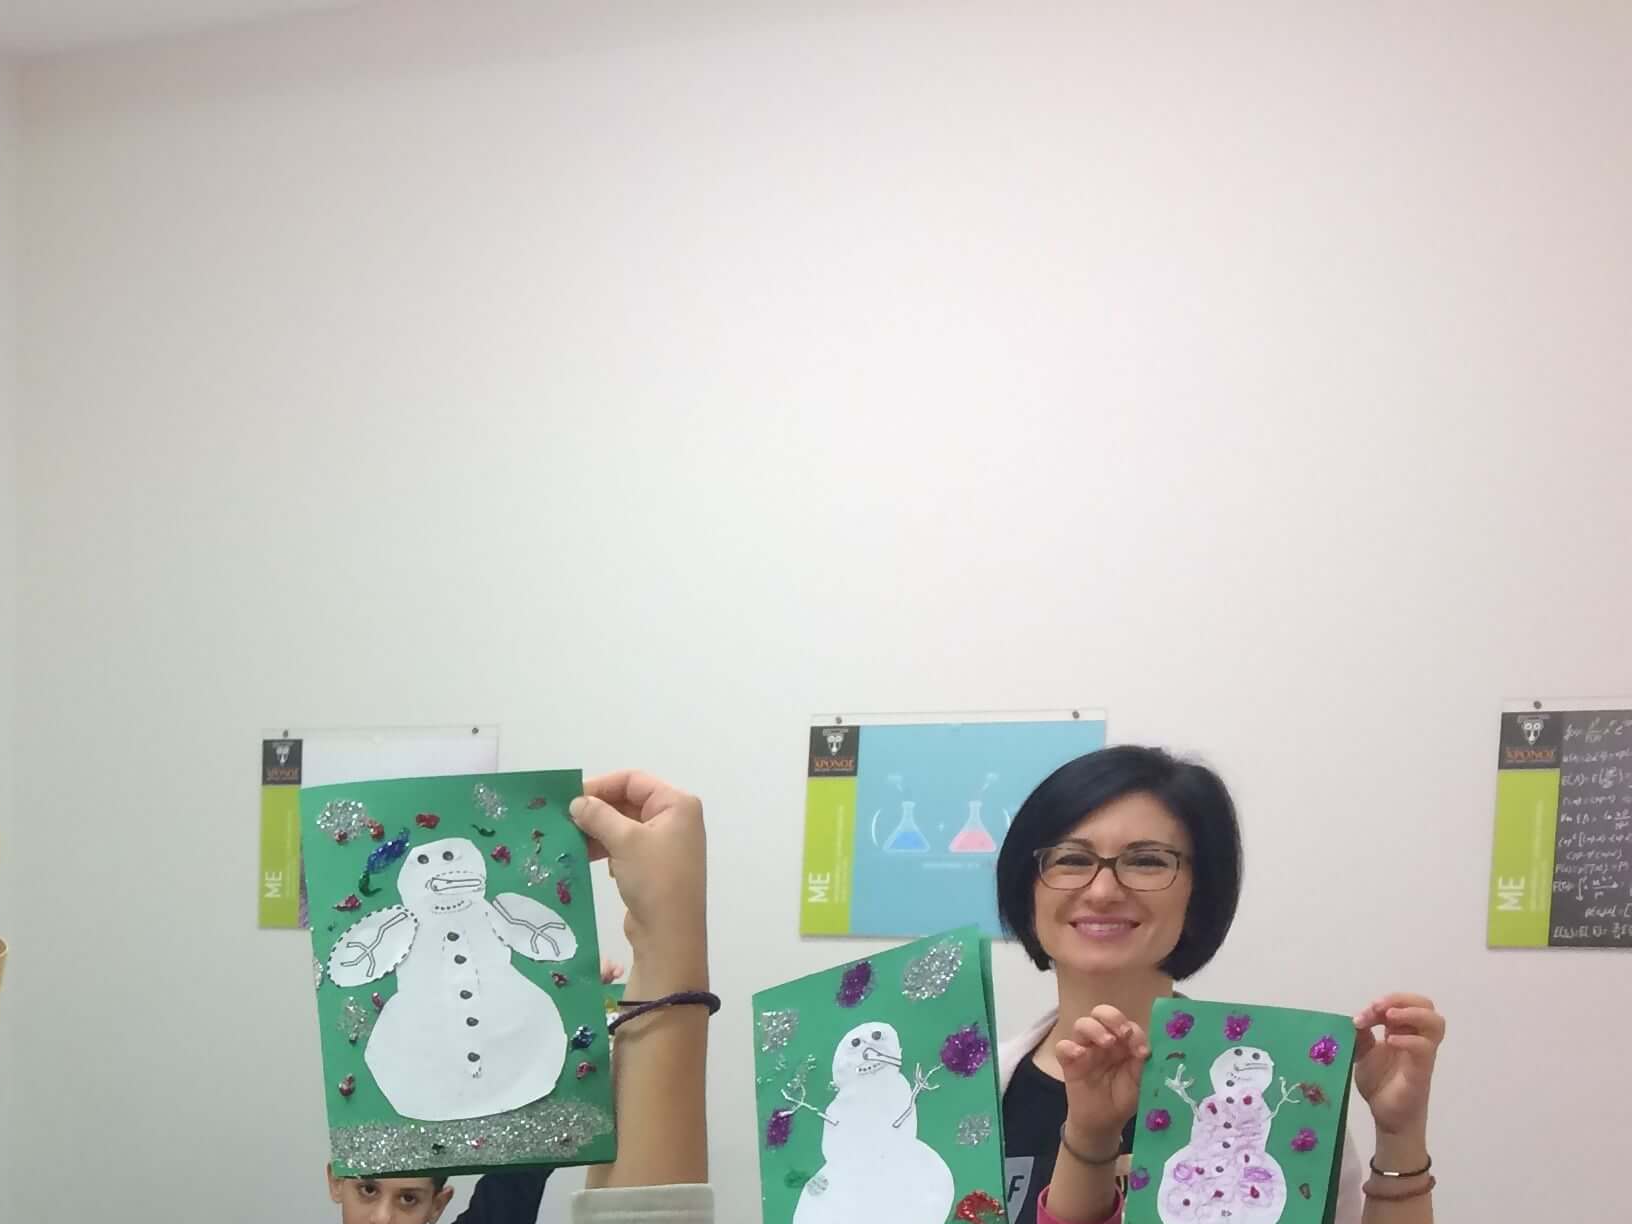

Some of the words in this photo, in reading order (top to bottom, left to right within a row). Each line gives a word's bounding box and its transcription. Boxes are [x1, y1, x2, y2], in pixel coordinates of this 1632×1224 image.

[264, 871, 283, 899] ME
[808, 871, 831, 904] ME
[1496, 876, 1526, 912] ME
